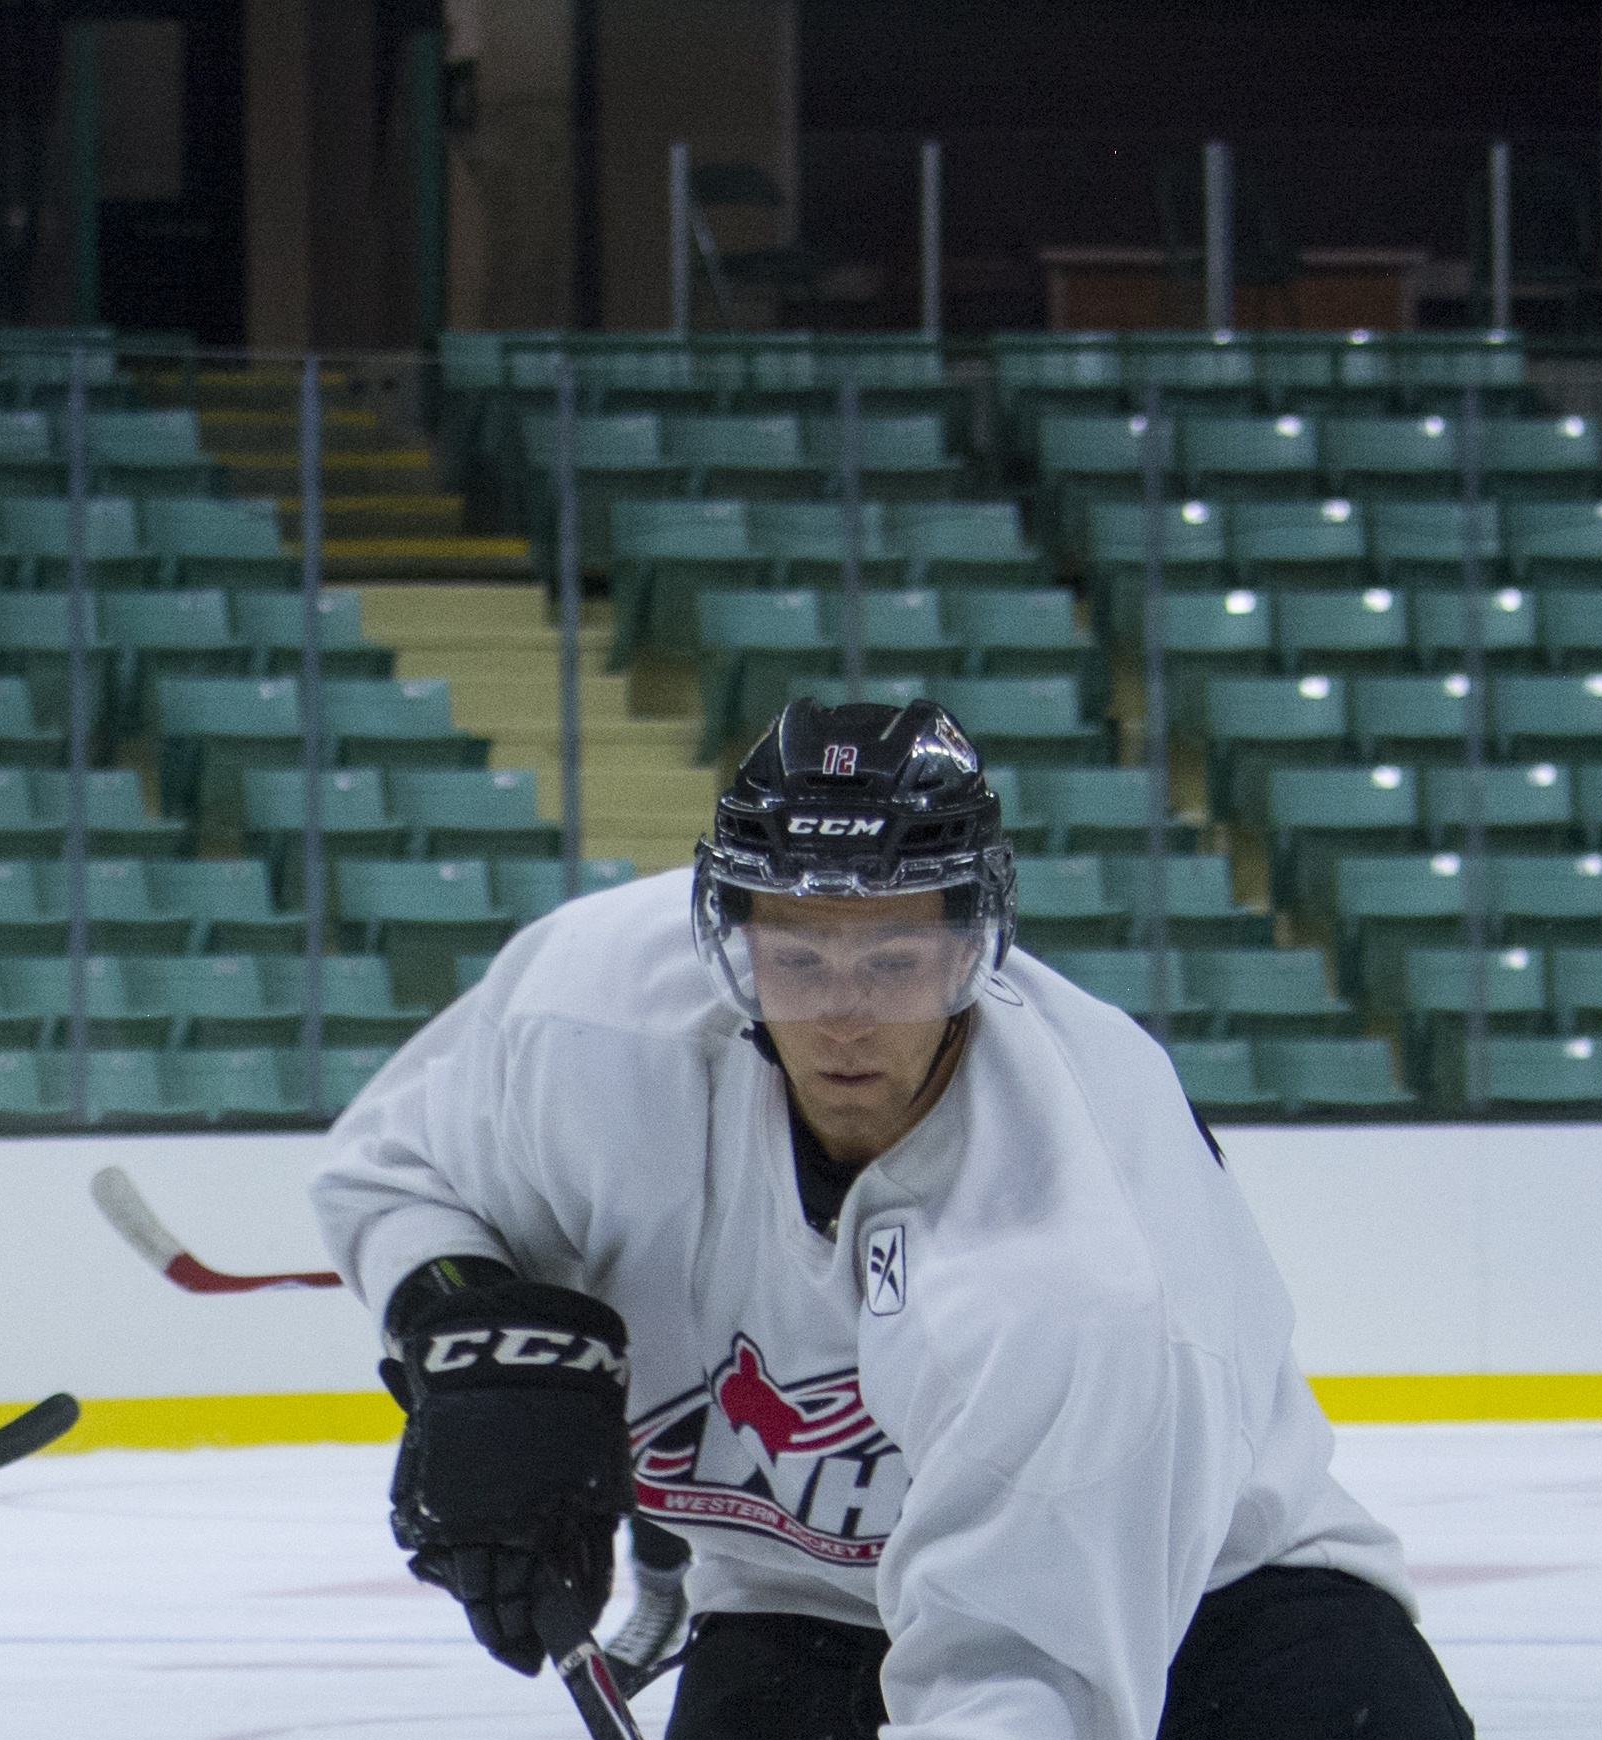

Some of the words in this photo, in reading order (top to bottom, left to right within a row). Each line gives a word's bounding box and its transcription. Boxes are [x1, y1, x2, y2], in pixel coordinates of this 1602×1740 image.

[823, 745, 857, 776] 12
[787, 817, 885, 836] CCM
[424, 1328, 628, 1387] CCM
[665, 1494, 778, 1524] WESTERN
[783, 1520, 859, 1556] HOCKEY
